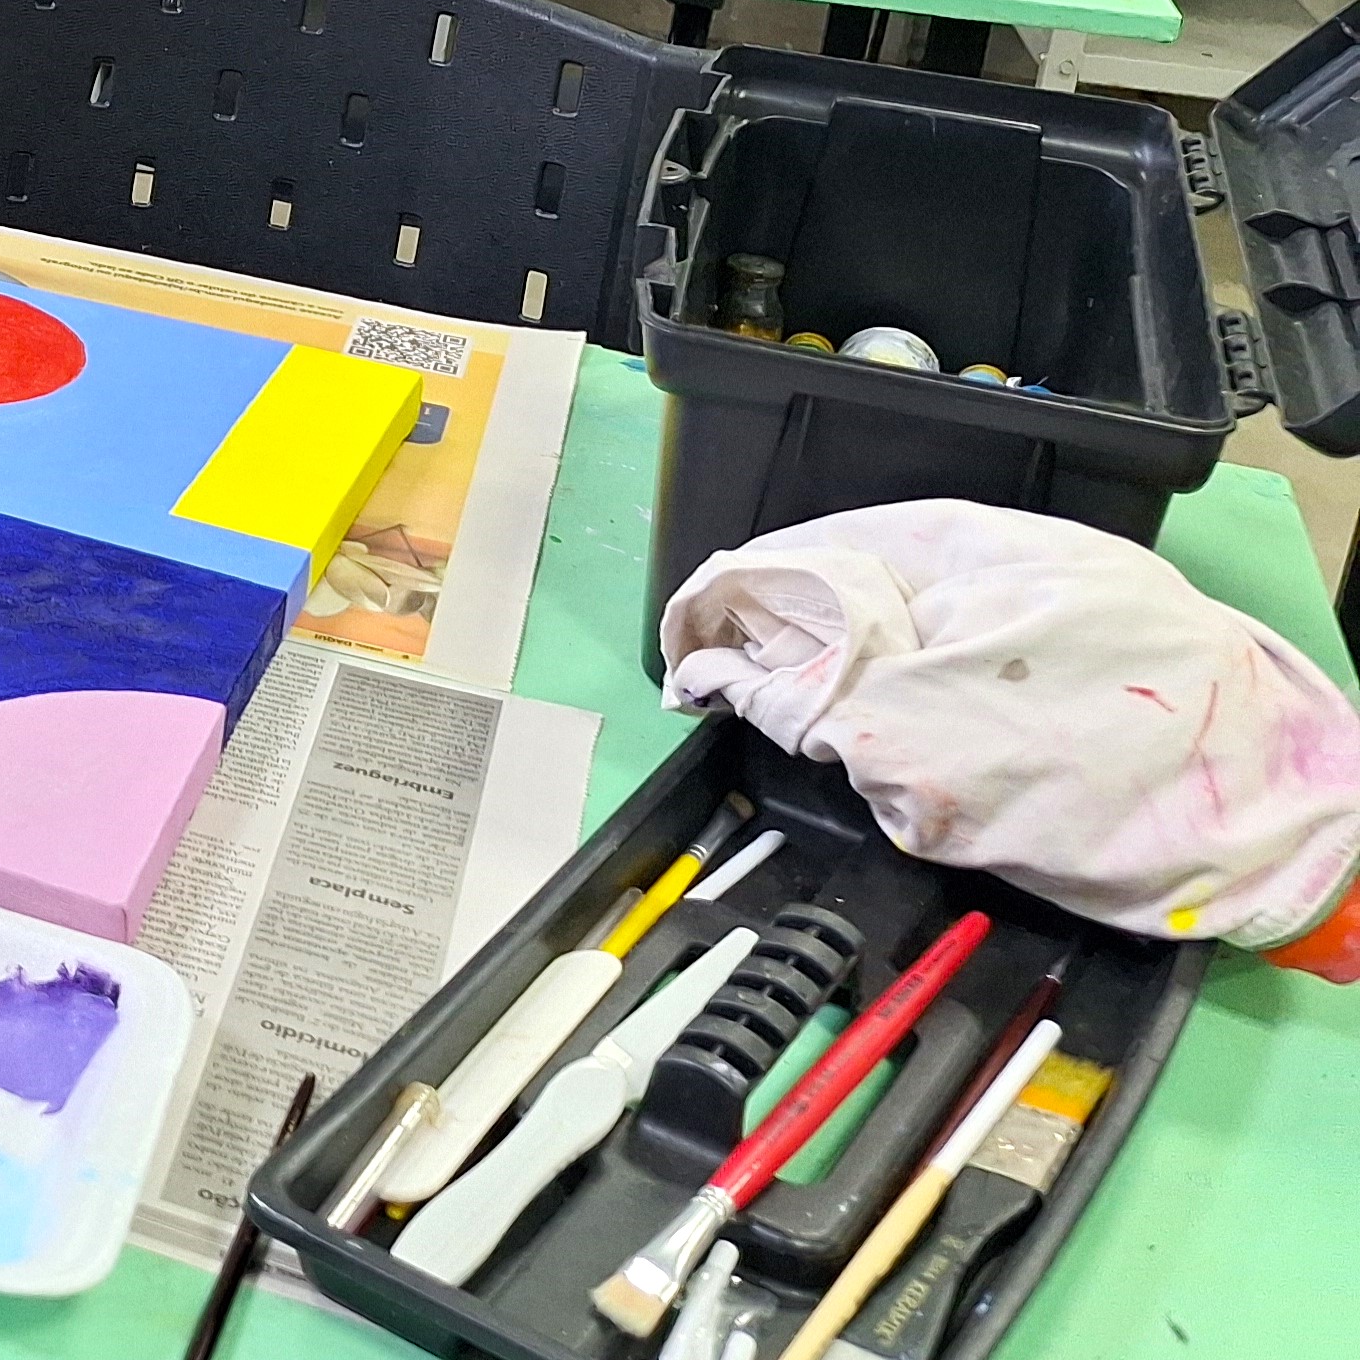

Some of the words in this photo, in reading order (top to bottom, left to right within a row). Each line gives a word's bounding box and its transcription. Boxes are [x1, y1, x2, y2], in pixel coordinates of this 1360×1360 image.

[333, 761, 455, 800] Embriaguez
[308, 875, 367, 902] placa
[367, 892, 415, 917] Sem
